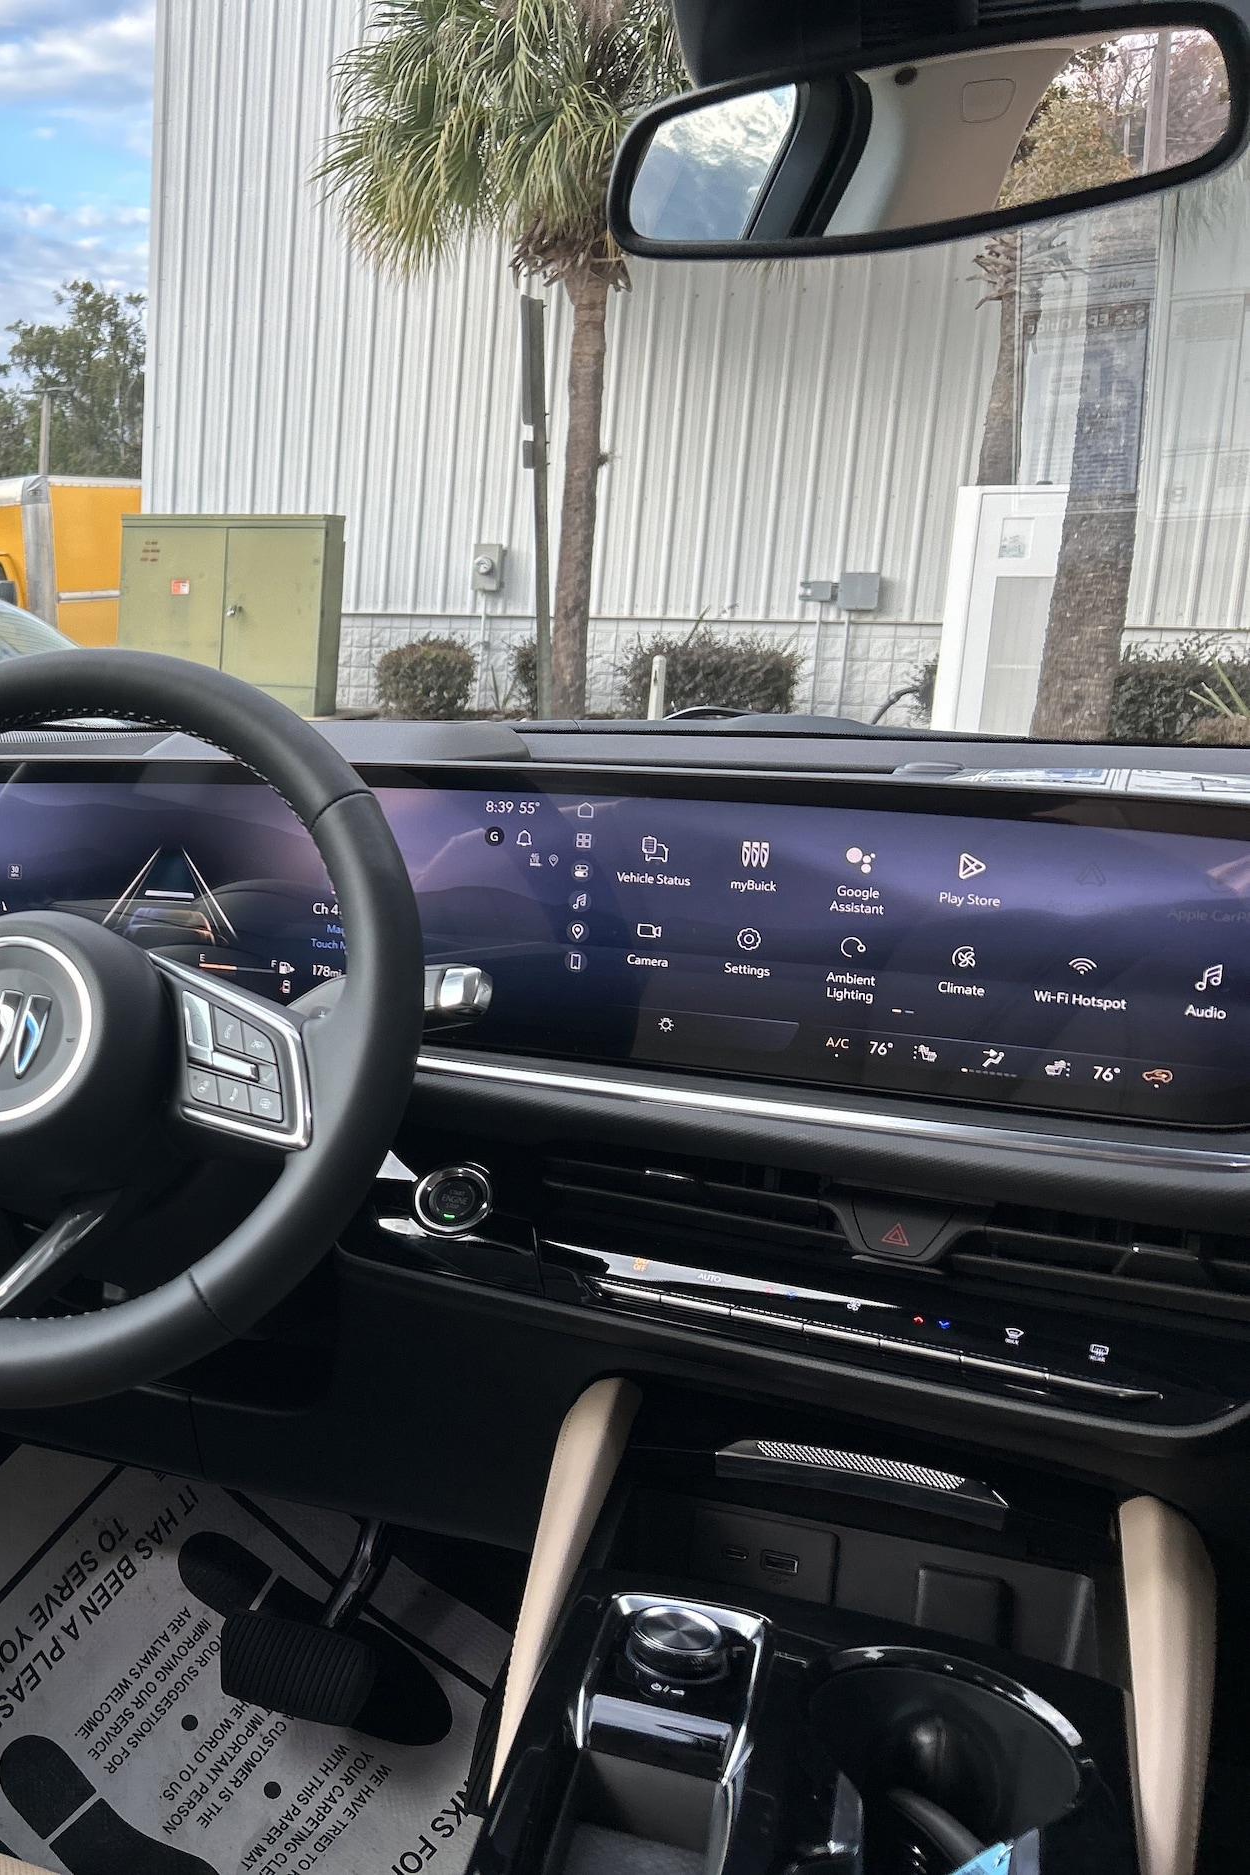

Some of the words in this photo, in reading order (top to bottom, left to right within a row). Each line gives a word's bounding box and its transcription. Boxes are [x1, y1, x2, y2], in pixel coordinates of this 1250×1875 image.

[485, 800, 514, 813] 8:39
[518, 801, 541, 815] 55°
[490, 831, 499, 842] G
[10, 865, 20, 873] 30
[617, 871, 655, 884] Vehicle
[656, 874, 691, 886] Status
[730, 880, 777, 893] myBuick
[836, 885, 880, 900] Google
[312, 902, 329, 915] Ch
[829, 900, 884, 916] Assistant
[939, 892, 965, 907] Play
[967, 893, 1001, 907] Store
[310, 938, 339, 950] Touch
[199, 953, 206, 962] E
[271, 959, 278, 968] F
[626, 954, 669, 968] Camera
[724, 962, 771, 978] Settings
[826, 971, 876, 986] Ambient
[826, 987, 874, 1004] Lighting
[937, 981, 986, 997] Climate
[1033, 989, 1069, 1004] Wi-Fi
[1071, 993, 1128, 1011] Hotspot
[1184, 1003, 1227, 1020] Audio
[825, 1036, 850, 1049] A/C
[869, 1040, 894, 1056] 76°
[1093, 1065, 1121, 1082] 76°
[697, 1273, 722, 1283] AUTO
[178, 1484, 199, 1516] IT
[97, 1517, 130, 1553] TO
[134, 1507, 179, 1560] HAS
[29, 1549, 99, 1631] SERVE
[78, 1554, 139, 1626] BEEN
[60, 1615, 81, 1641] A
[168, 1606, 192, 1635] ARE
[129, 1631, 171, 1680] ALWAYS
[155, 1617, 212, 1682] IMPROVING
[127, 1666, 199, 1749] SUGGESTIONS
[131, 1681, 157, 1711] OUR
[74, 1678, 133, 1740] WELCOME.
[229, 1700, 250, 1720] HE
[87, 1707, 135, 1761] SERVICE
[193, 1718, 236, 1764] WORLD
[103, 1746, 131, 1774] FOR
[210, 1713, 265, 1785] IMPORTANT
[230, 1721, 287, 1789] CUSTOMER
[318, 1744, 351, 1777] WITH
[179, 1763, 199, 1783] TO
[339, 1751, 375, 1787] YOUR
[369, 1763, 392, 1787] WE
[218, 1787, 234, 1803] IS
[296, 1775, 325, 1806] THIS
[162, 1782, 210, 1836] PERSON
[342, 1786, 375, 1820] HAVE
[196, 1805, 224, 1829] THE
[261, 1803, 302, 1845] PAPER
[284, 1785, 345, 1854] CARPETING
[313, 1820, 349, 1853] TRIED
[241, 1843, 267, 1872] MAT
[260, 1852, 288, 1875] CLE
[298, 1853, 318, 1871] TO
